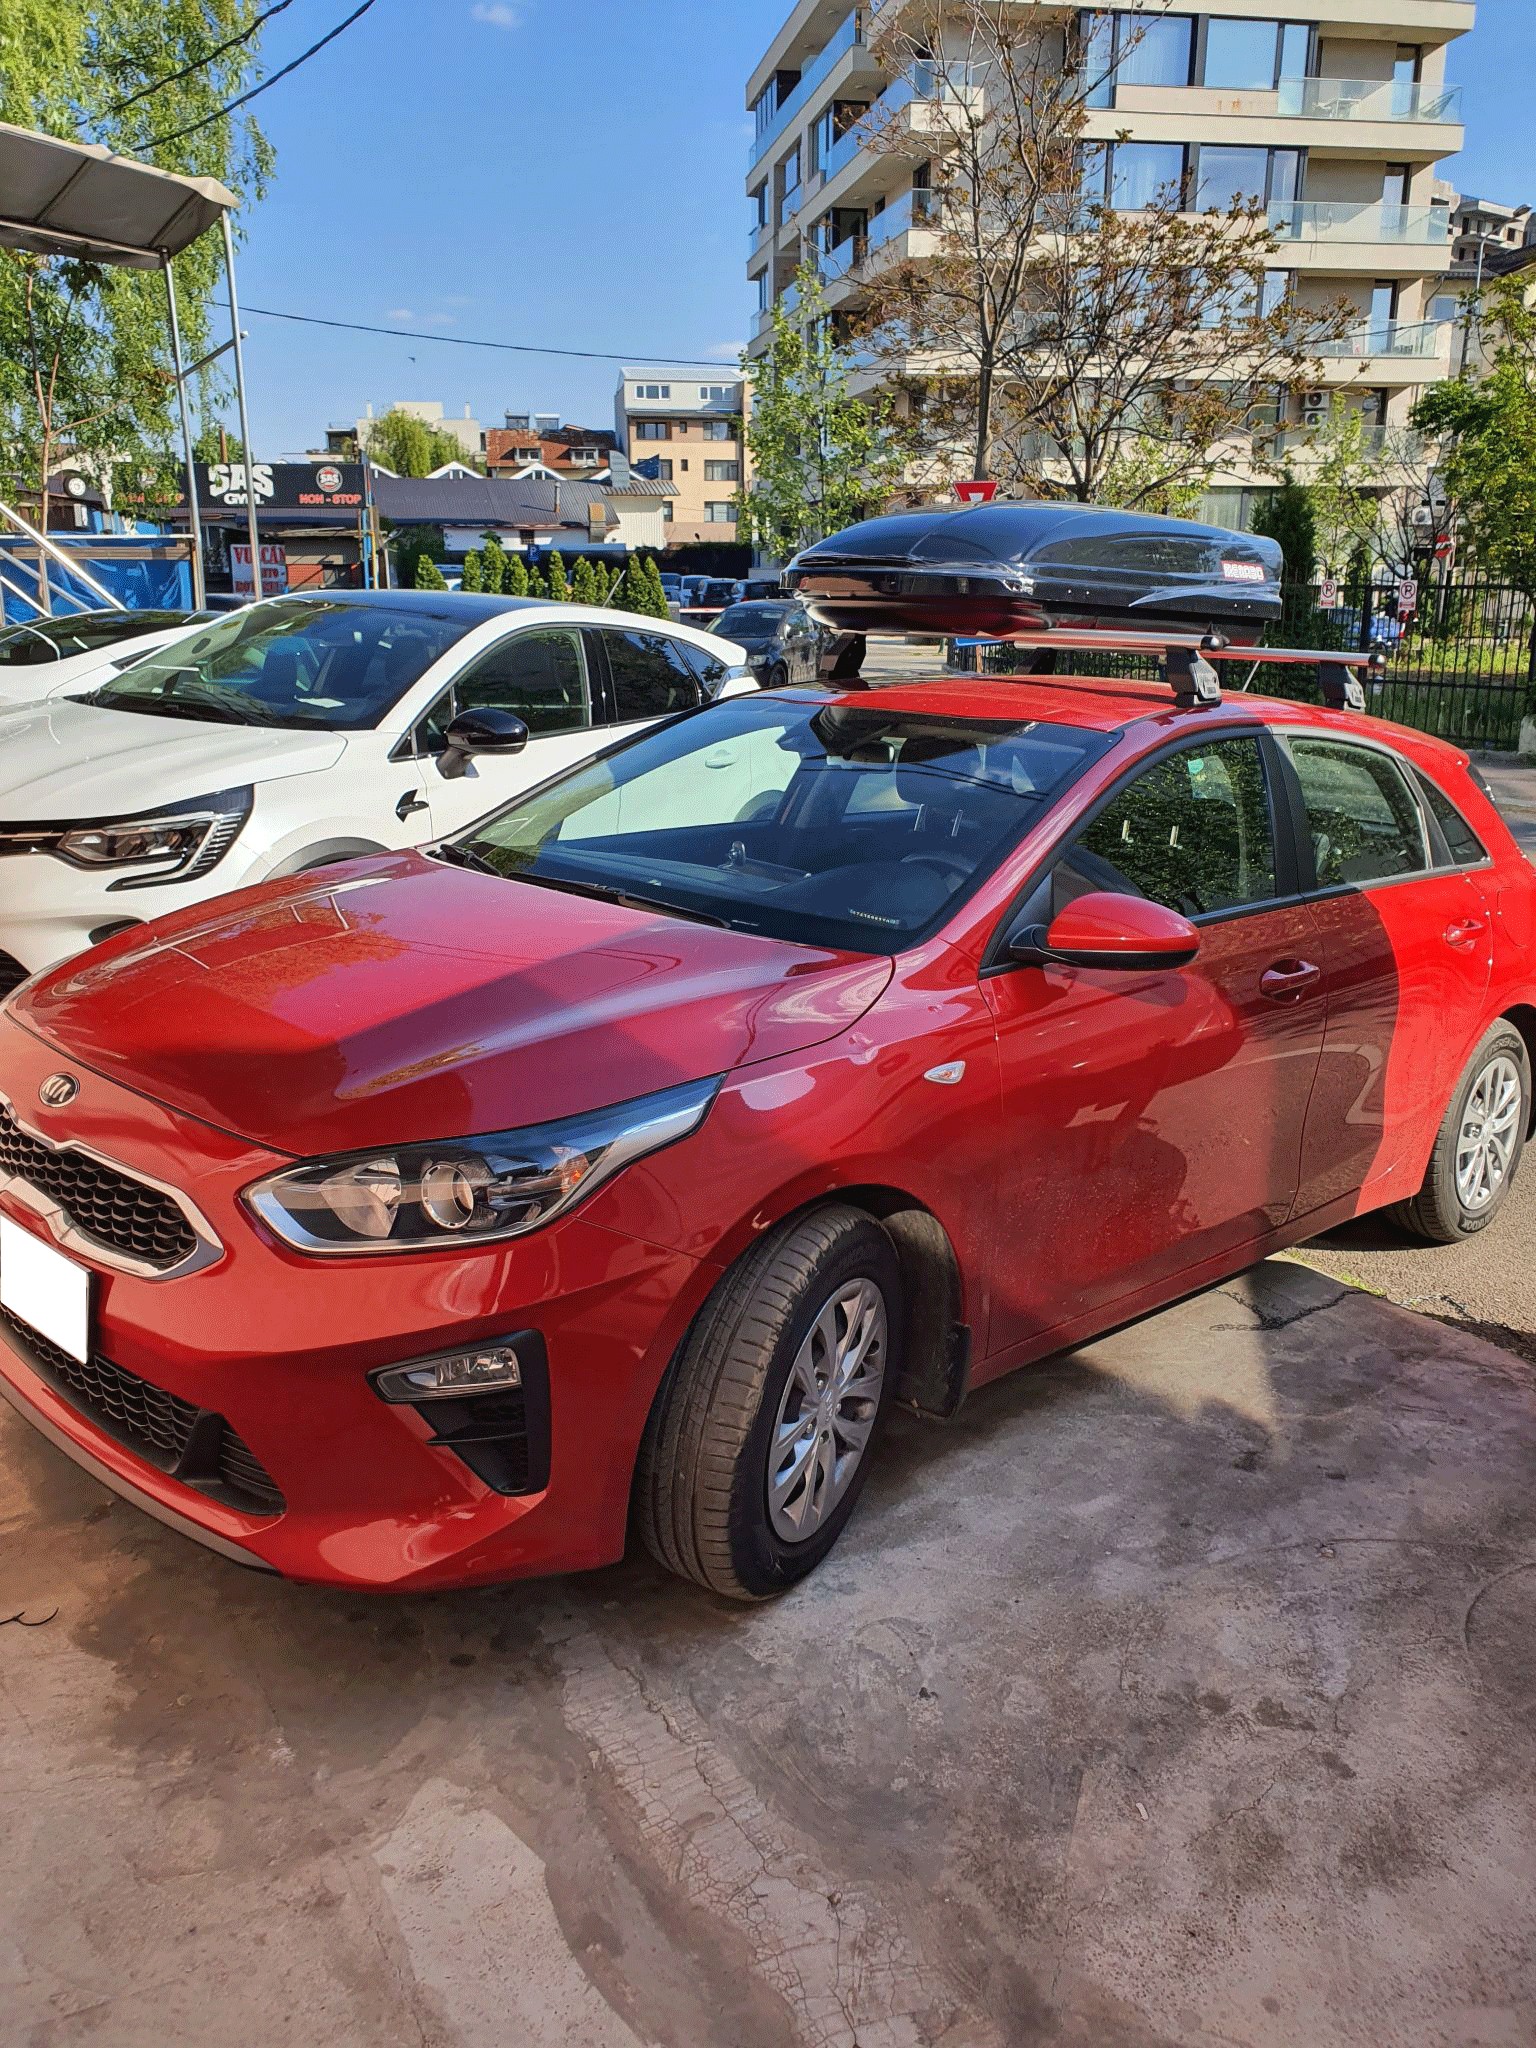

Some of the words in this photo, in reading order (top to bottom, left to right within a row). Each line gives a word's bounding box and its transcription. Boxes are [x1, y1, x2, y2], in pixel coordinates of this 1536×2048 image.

[208, 464, 275, 498] SAS
[332, 493, 362, 504] STOP
[42, 1077, 71, 1102] KIA
